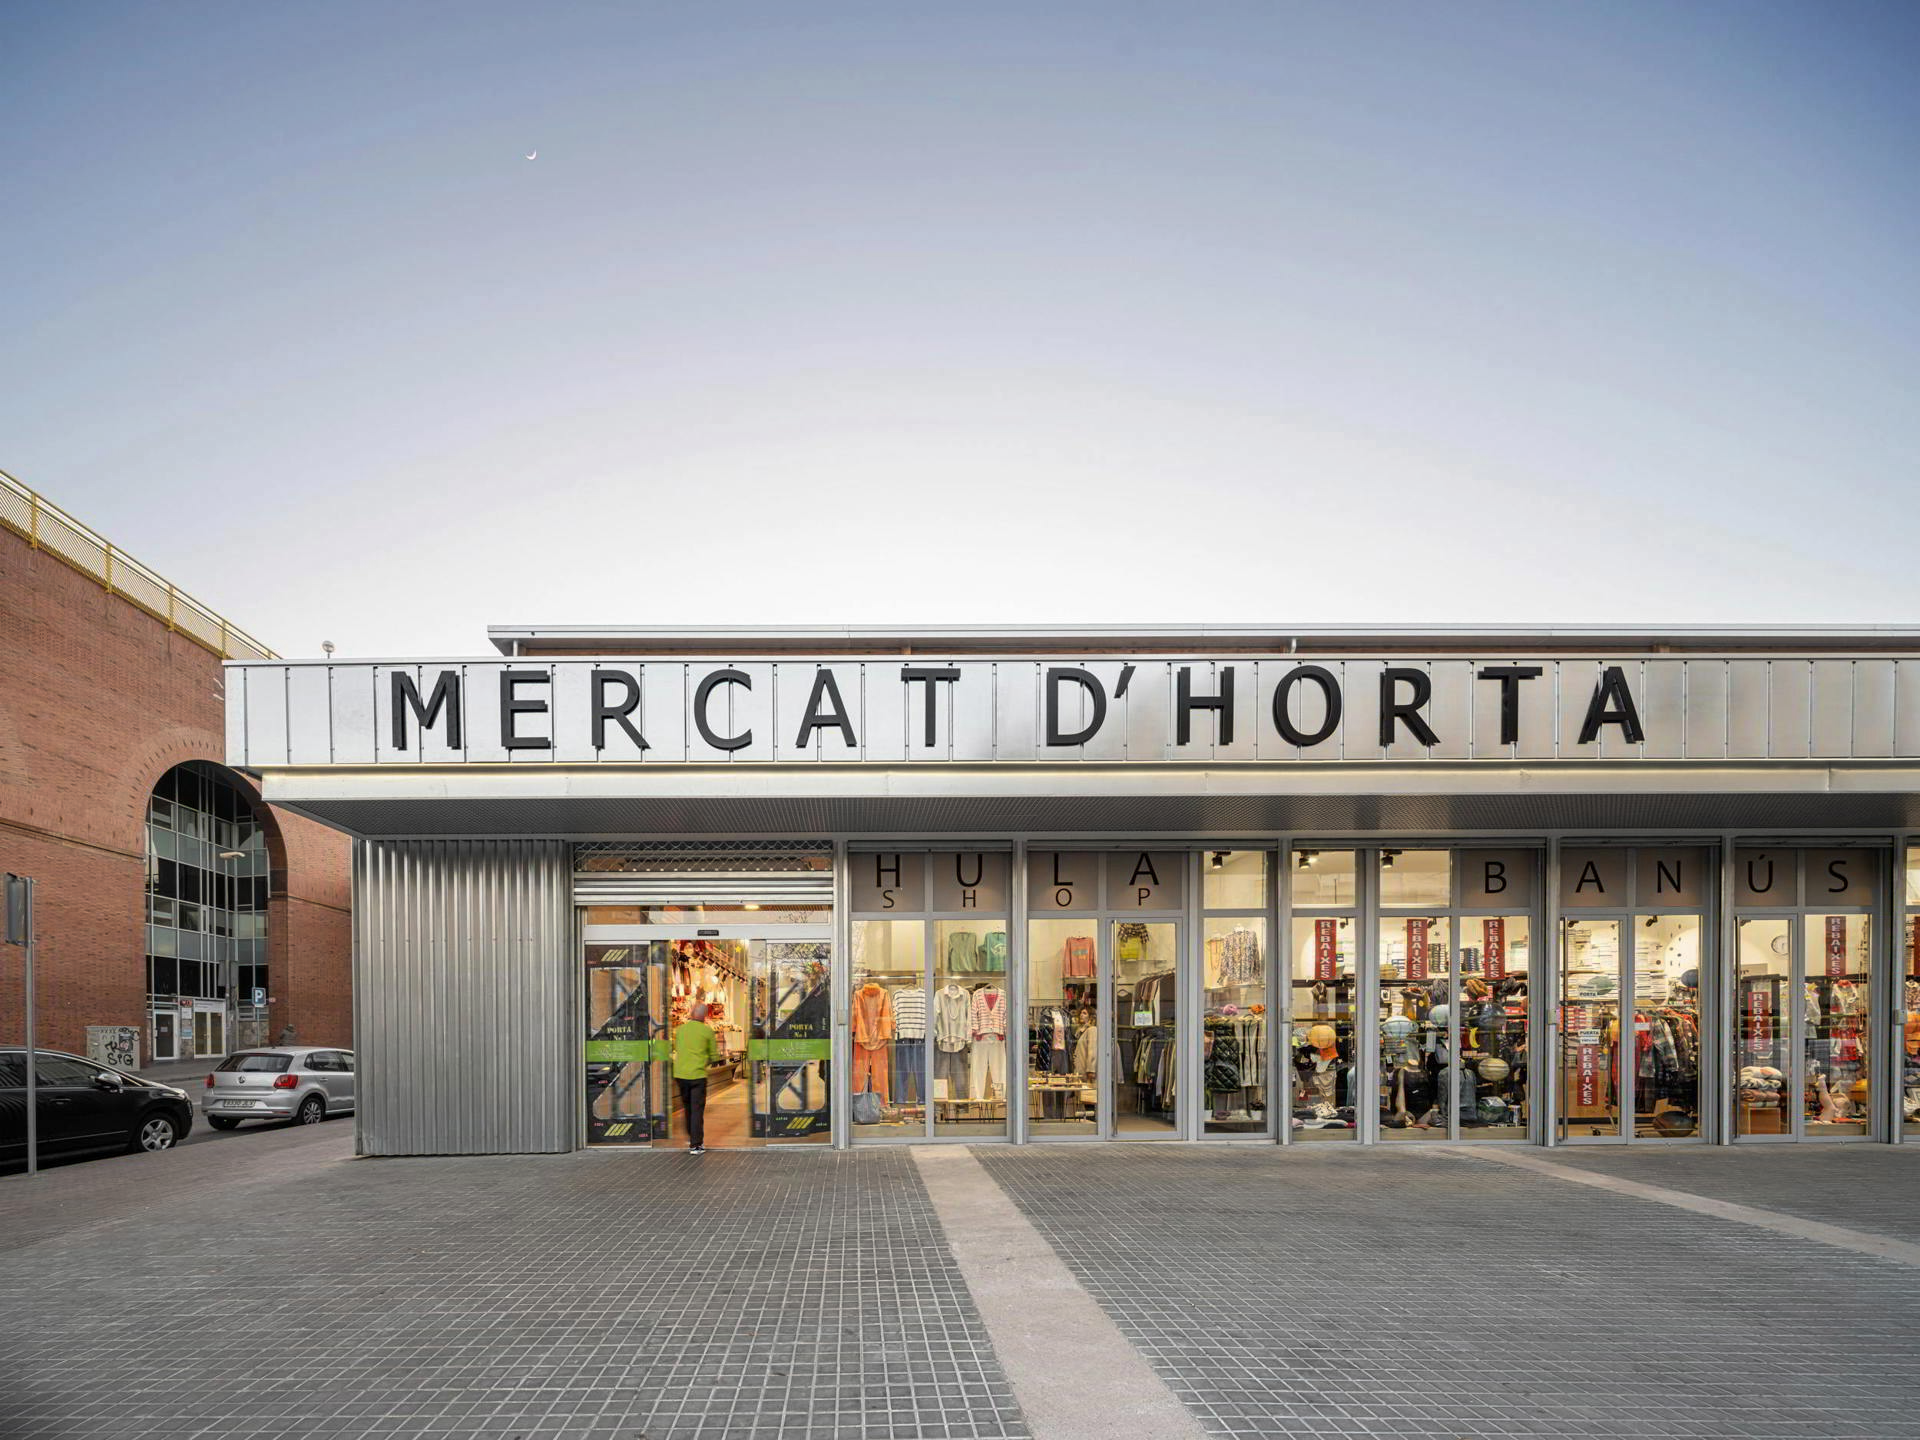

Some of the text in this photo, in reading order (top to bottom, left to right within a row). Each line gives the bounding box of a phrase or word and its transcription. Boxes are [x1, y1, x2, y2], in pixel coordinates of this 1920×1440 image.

[391, 665, 1645, 751] MERCAT D'HORTA
[1320, 920, 1332, 979] REBAIXES
[1412, 920, 1423, 979] REBAIXES
[1488, 920, 1500, 979] REBAIXES
[1831, 917, 1841, 975] REBAIXES
[255, 989, 263, 1003] P
[1753, 993, 1763, 1051] REBAIXES
[789, 1023, 813, 1031] PORTA
[1582, 1047, 1593, 1105] REBAIXES
